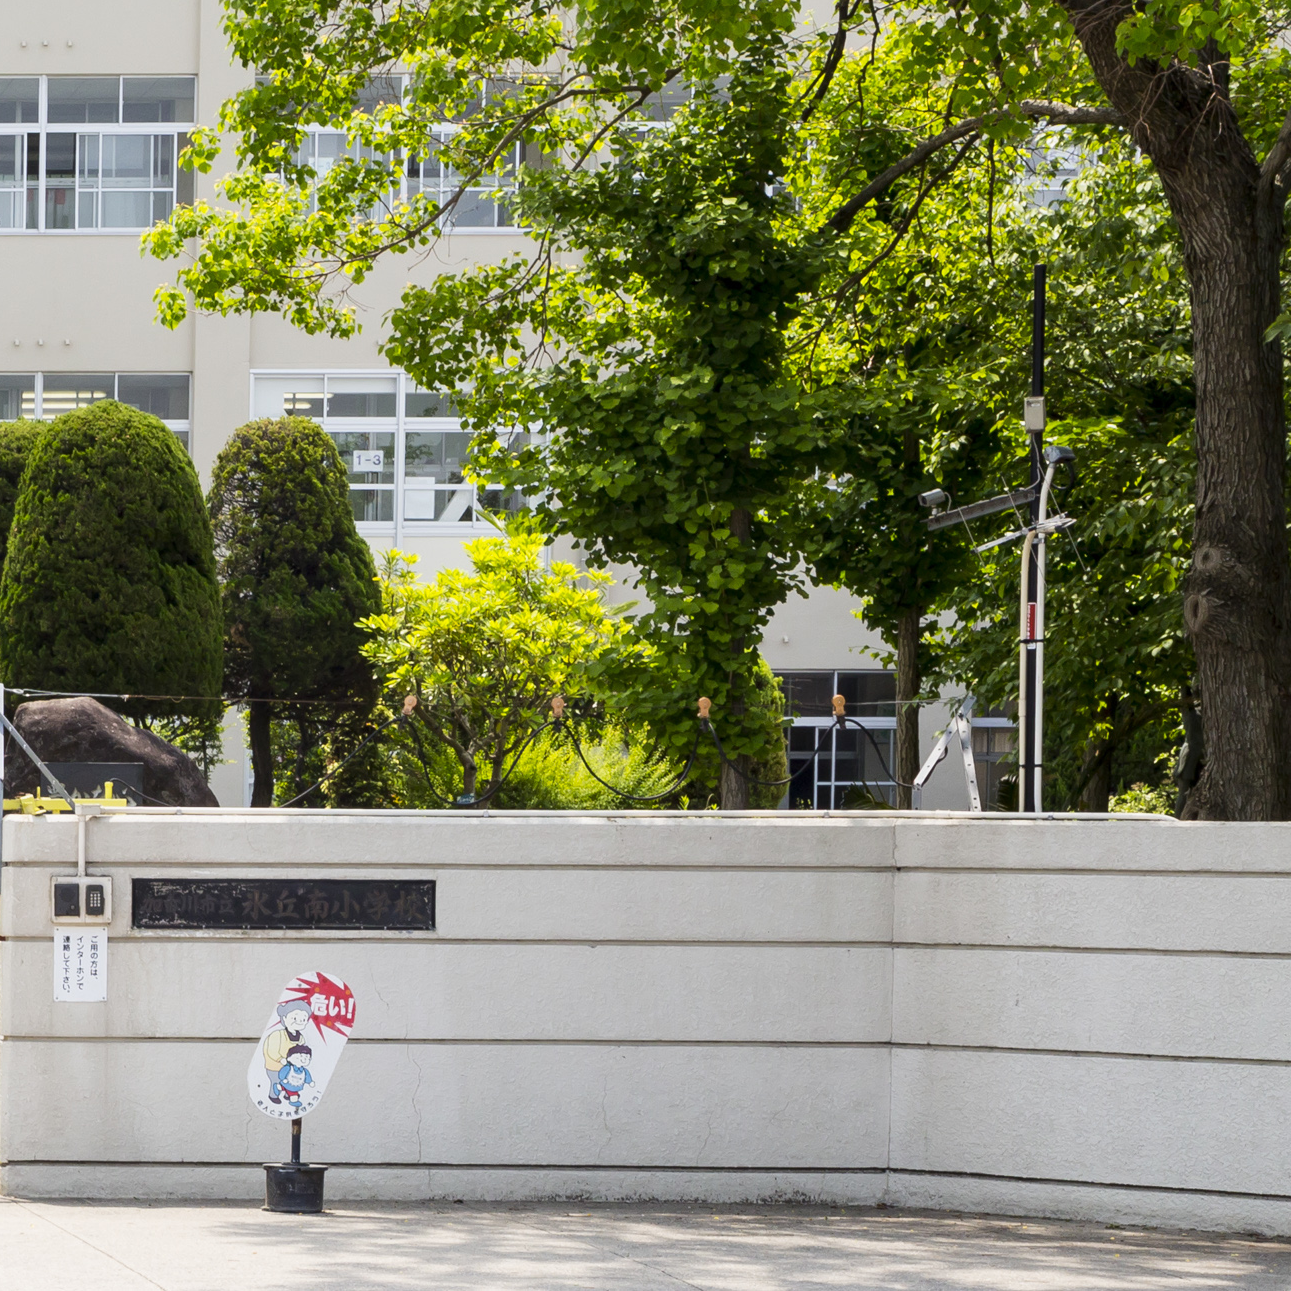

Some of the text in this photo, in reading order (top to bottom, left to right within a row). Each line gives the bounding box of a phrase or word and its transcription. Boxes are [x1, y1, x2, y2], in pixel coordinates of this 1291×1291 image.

[356, 454, 382, 466] 1-3
[62, 935, 71, 993] 連絡して下さい。
[76, 936, 84, 990] インターホンで
[90, 935, 99, 980] ご用の方は、
